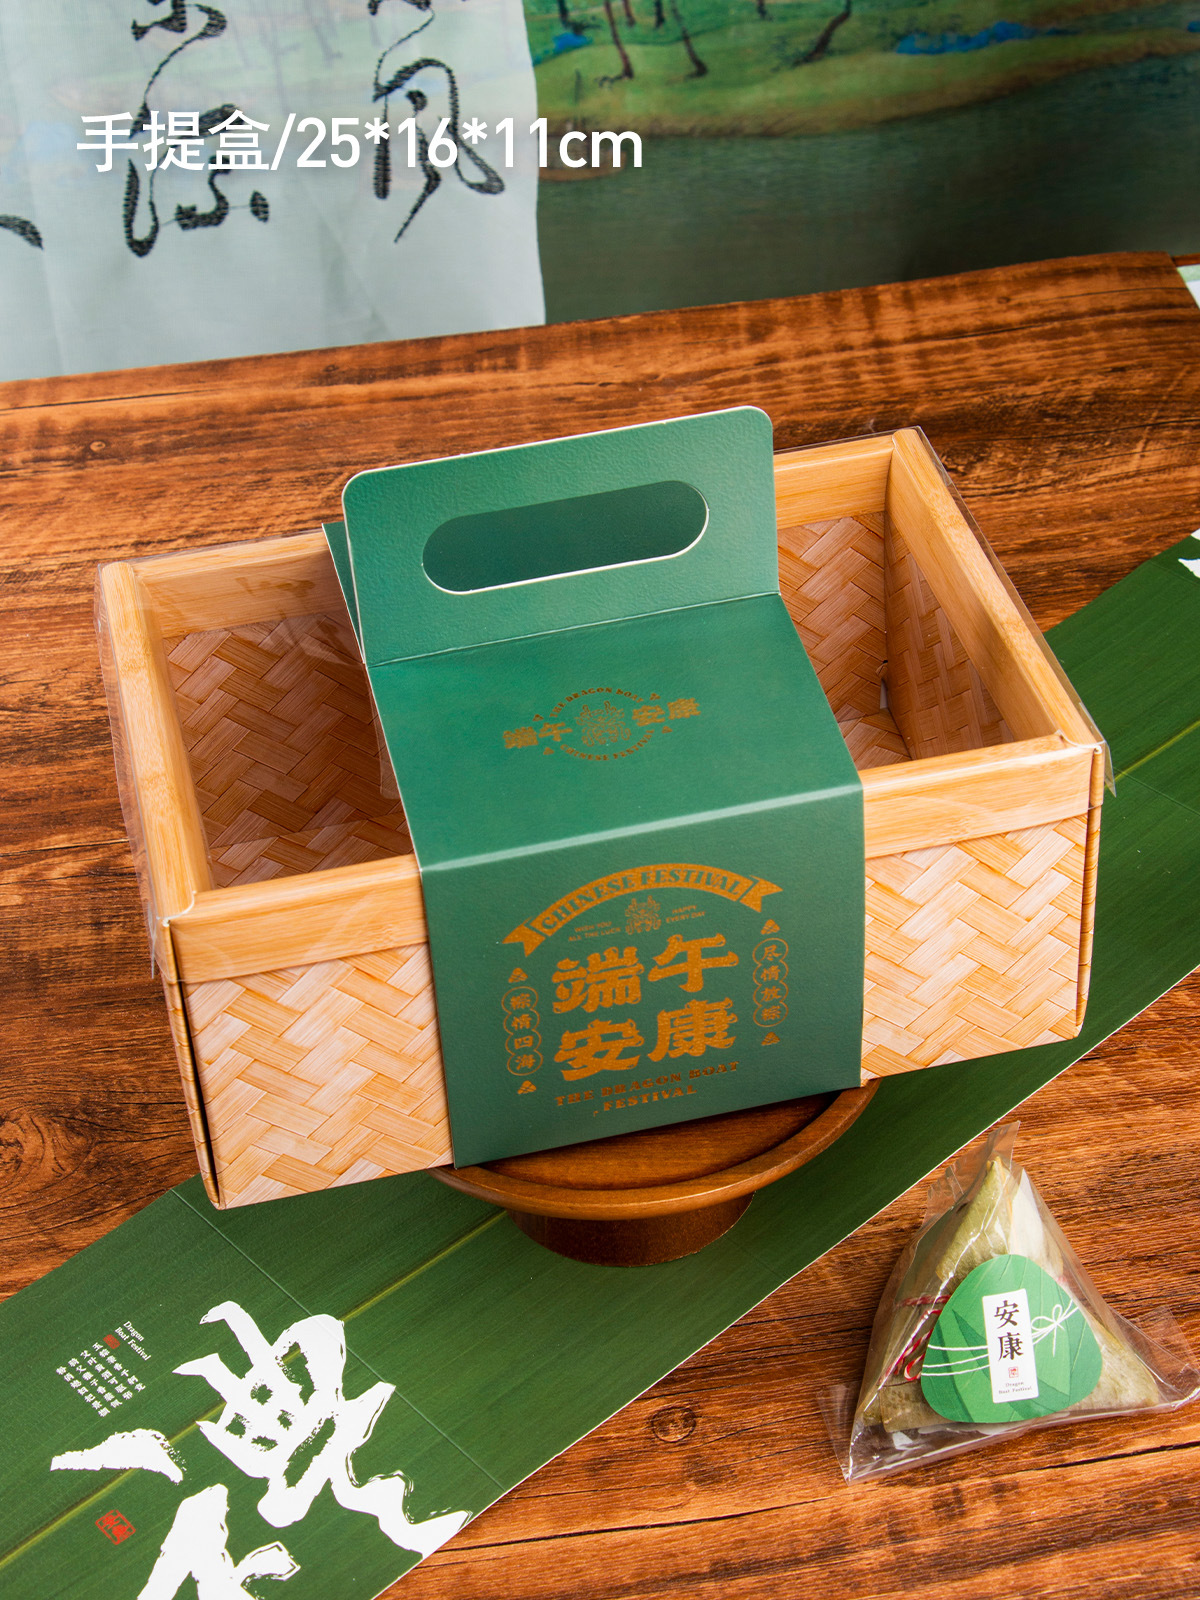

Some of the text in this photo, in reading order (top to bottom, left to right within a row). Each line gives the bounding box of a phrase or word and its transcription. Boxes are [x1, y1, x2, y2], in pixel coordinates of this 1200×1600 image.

[540, 869, 743, 931] CHINESE FESTIVAL
[551, 933, 740, 1014] 端午
[553, 997, 739, 1081] 安康
[554, 1061, 740, 1107] THE DRAGON BOAT
[603, 1085, 698, 1112] FESTIVAL
[115, 1327, 130, 1341] Boat
[128, 1339, 151, 1361] Festival
[123, 1320, 145, 1342] Dragon
[994, 1300, 1023, 1362] 安康
